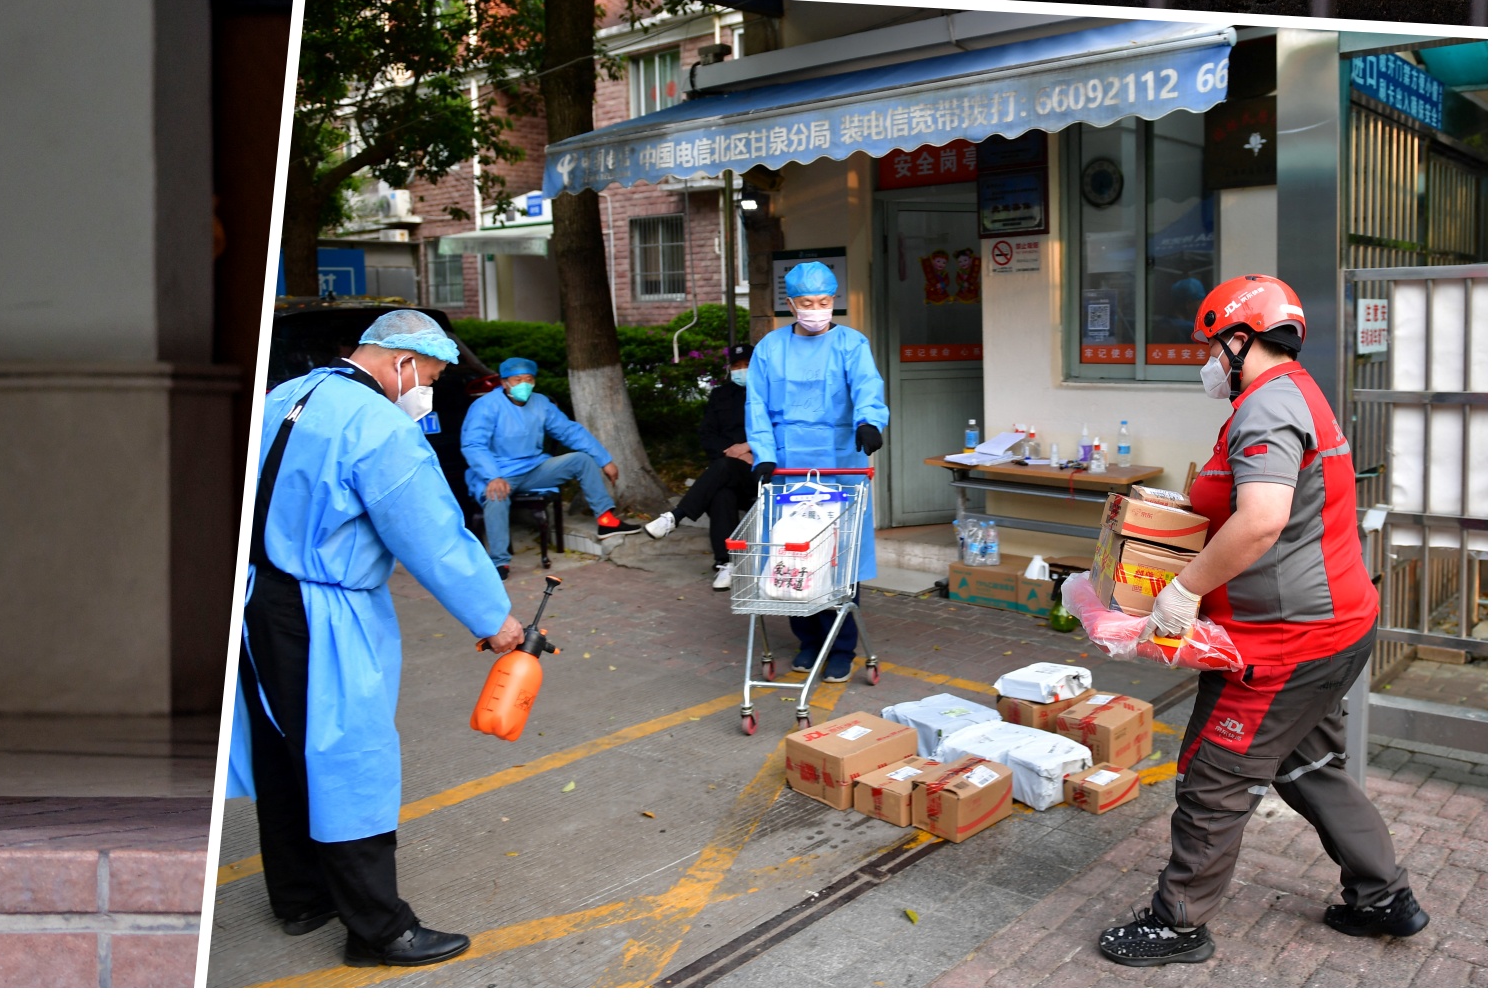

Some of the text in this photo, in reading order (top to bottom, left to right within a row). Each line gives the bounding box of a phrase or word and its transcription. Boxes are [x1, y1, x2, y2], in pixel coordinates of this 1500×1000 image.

[1352, 55, 1377, 89] 进口
[639, 119, 832, 171] 中国电信北区甘泉分局
[893, 145, 977, 179] 安全岗亭
[1223, 300, 1241, 318] JDL
[904, 347, 951, 358] 牢记使命
[1084, 348, 1135, 359] 牢记使命
[1219, 717, 1245, 735] JDL
